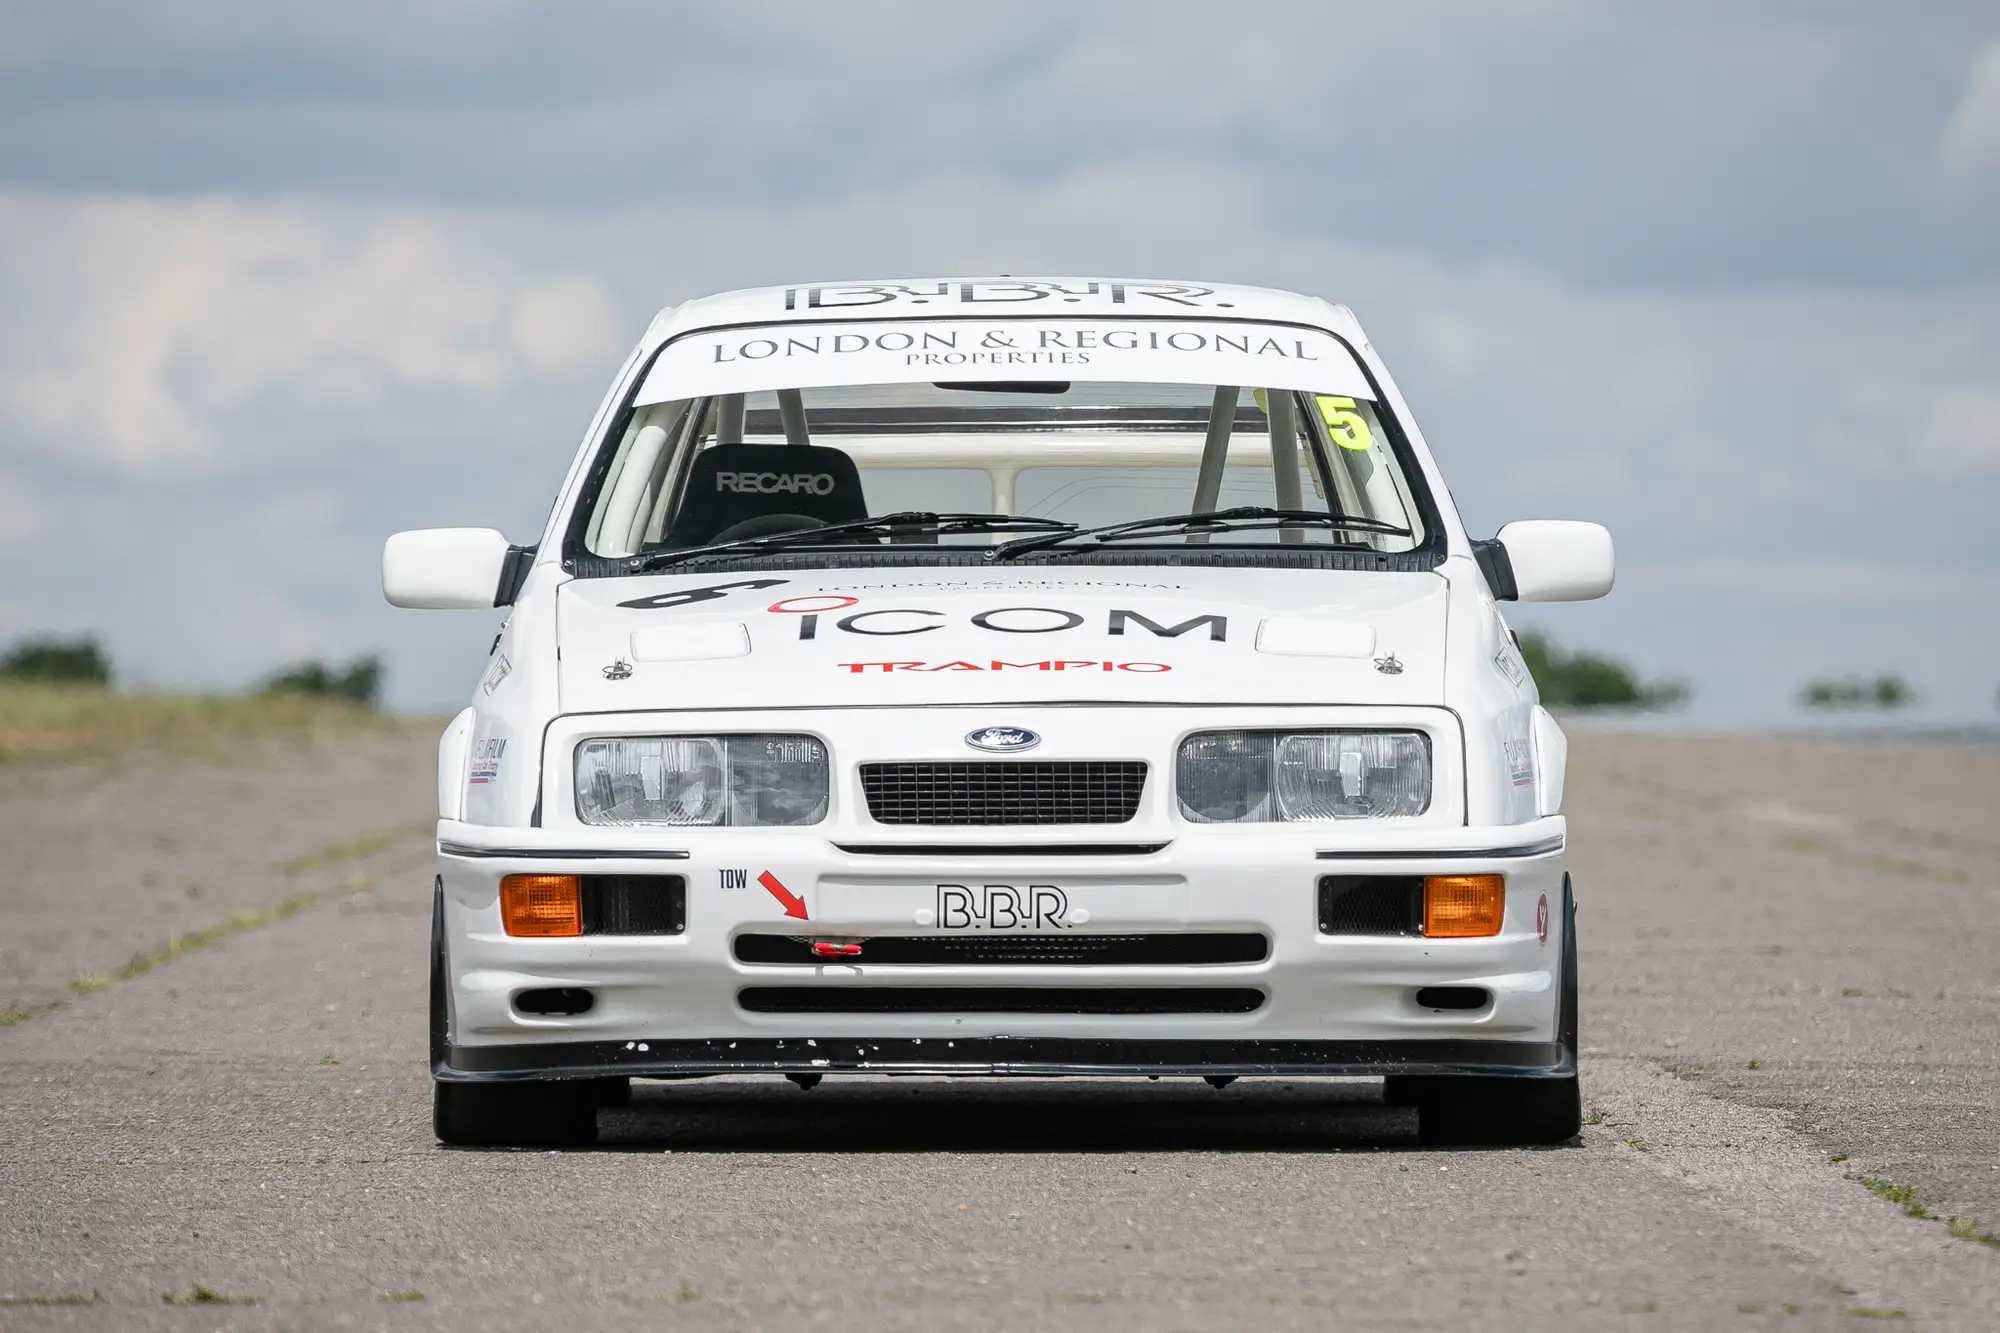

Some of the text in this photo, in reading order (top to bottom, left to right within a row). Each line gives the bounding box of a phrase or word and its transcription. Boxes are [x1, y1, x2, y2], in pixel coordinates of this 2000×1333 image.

[712, 330, 1318, 363] LONDON & REGIONAL
[906, 352, 1090, 365] PROPERTIES
[1315, 395, 1374, 451] 5
[716, 471, 835, 495] RECARO
[818, 580, 968, 592] LONDON
[837, 660, 1172, 673] TRAMPIO
[981, 728, 1025, 746] Ford
[719, 868, 747, 890] TOW
